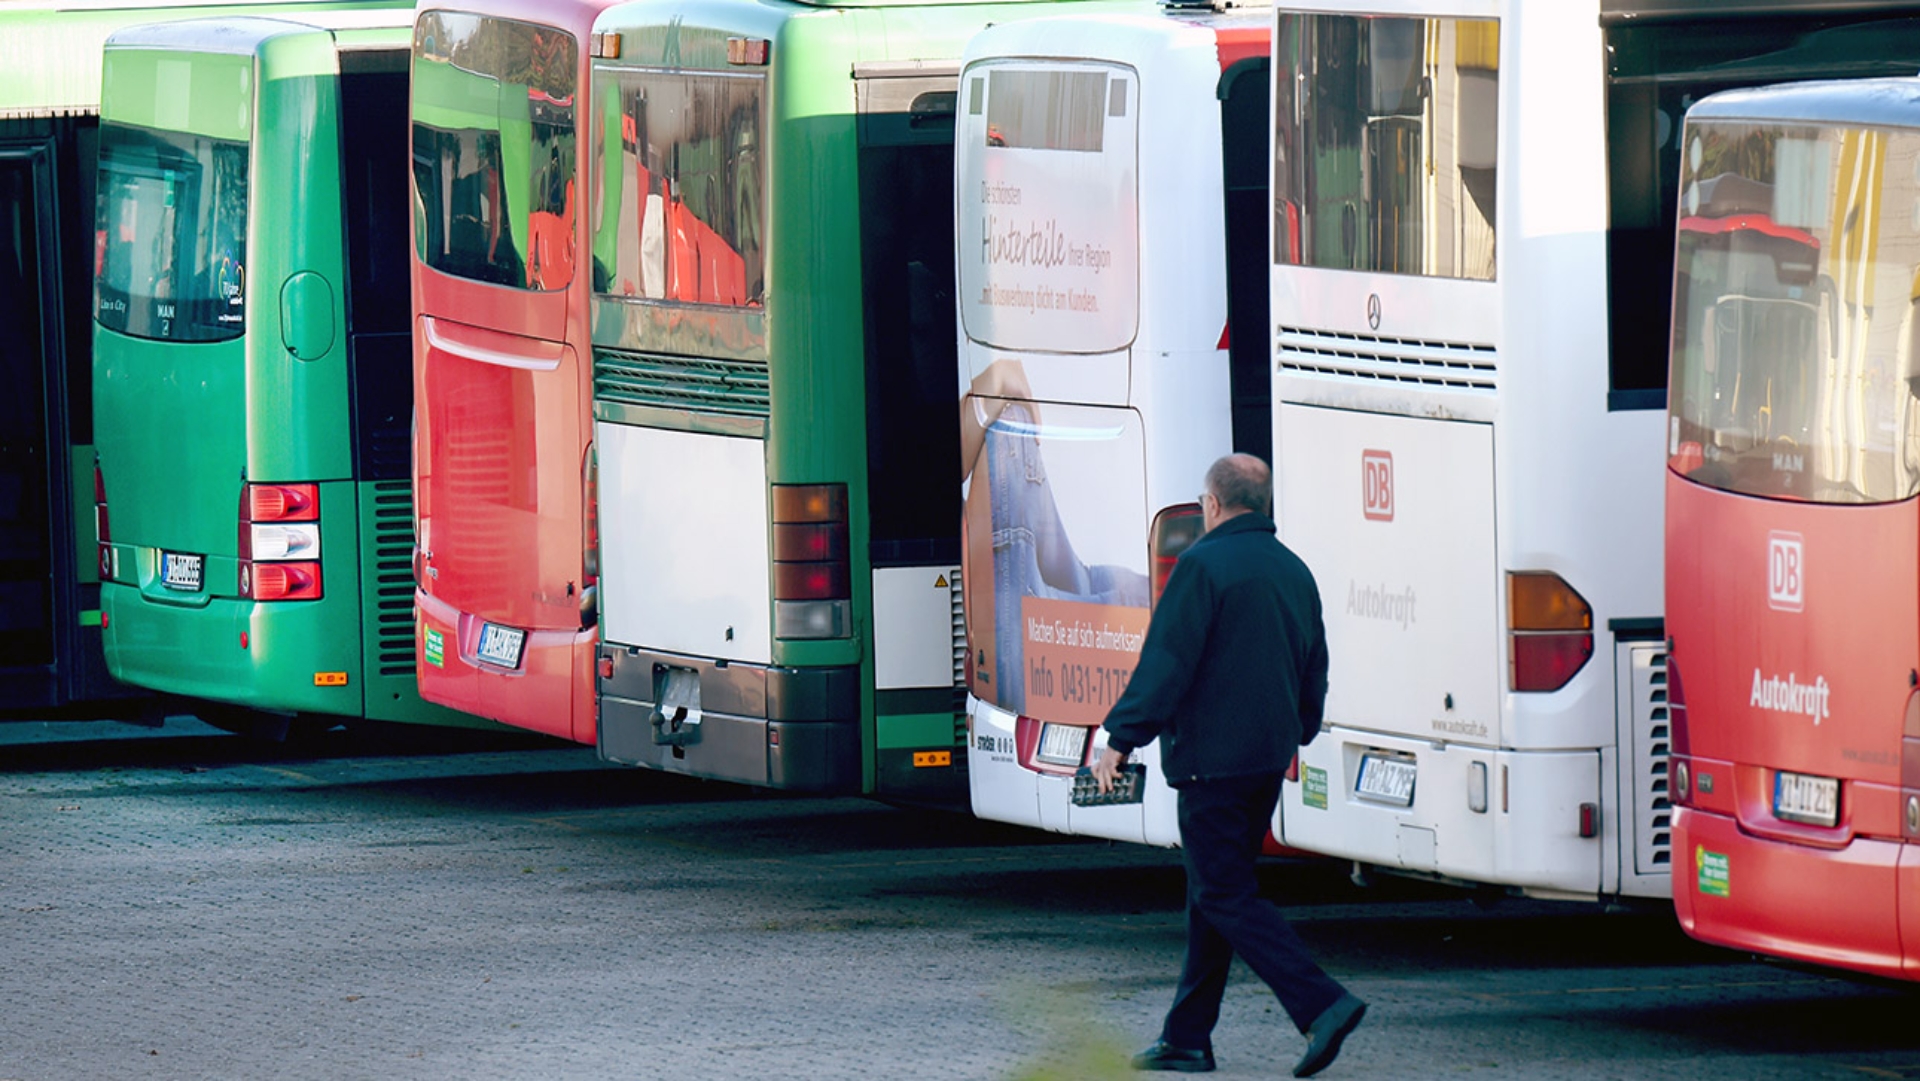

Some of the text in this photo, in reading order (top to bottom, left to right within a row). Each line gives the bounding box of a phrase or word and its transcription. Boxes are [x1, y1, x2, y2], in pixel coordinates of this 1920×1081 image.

[981, 214, 1066, 269] Hinterteile
[1085, 243, 1111, 274] Region
[157, 304, 175, 318] MAN
[1036, 284, 1054, 310] dicht
[1056, 291, 1066, 310] am
[1364, 459, 1391, 510] DB
[1773, 452, 1803, 472] MAN
[1770, 541, 1800, 598] DB
[1346, 579, 1416, 631] Autokraft
[1028, 617, 1053, 643] Machen
[1055, 620, 1066, 645] Sie
[1067, 620, 1079, 647] auf
[1080, 622, 1094, 648] sich
[1030, 655, 1053, 697] Info
[1751, 667, 1829, 726] Autokraft
